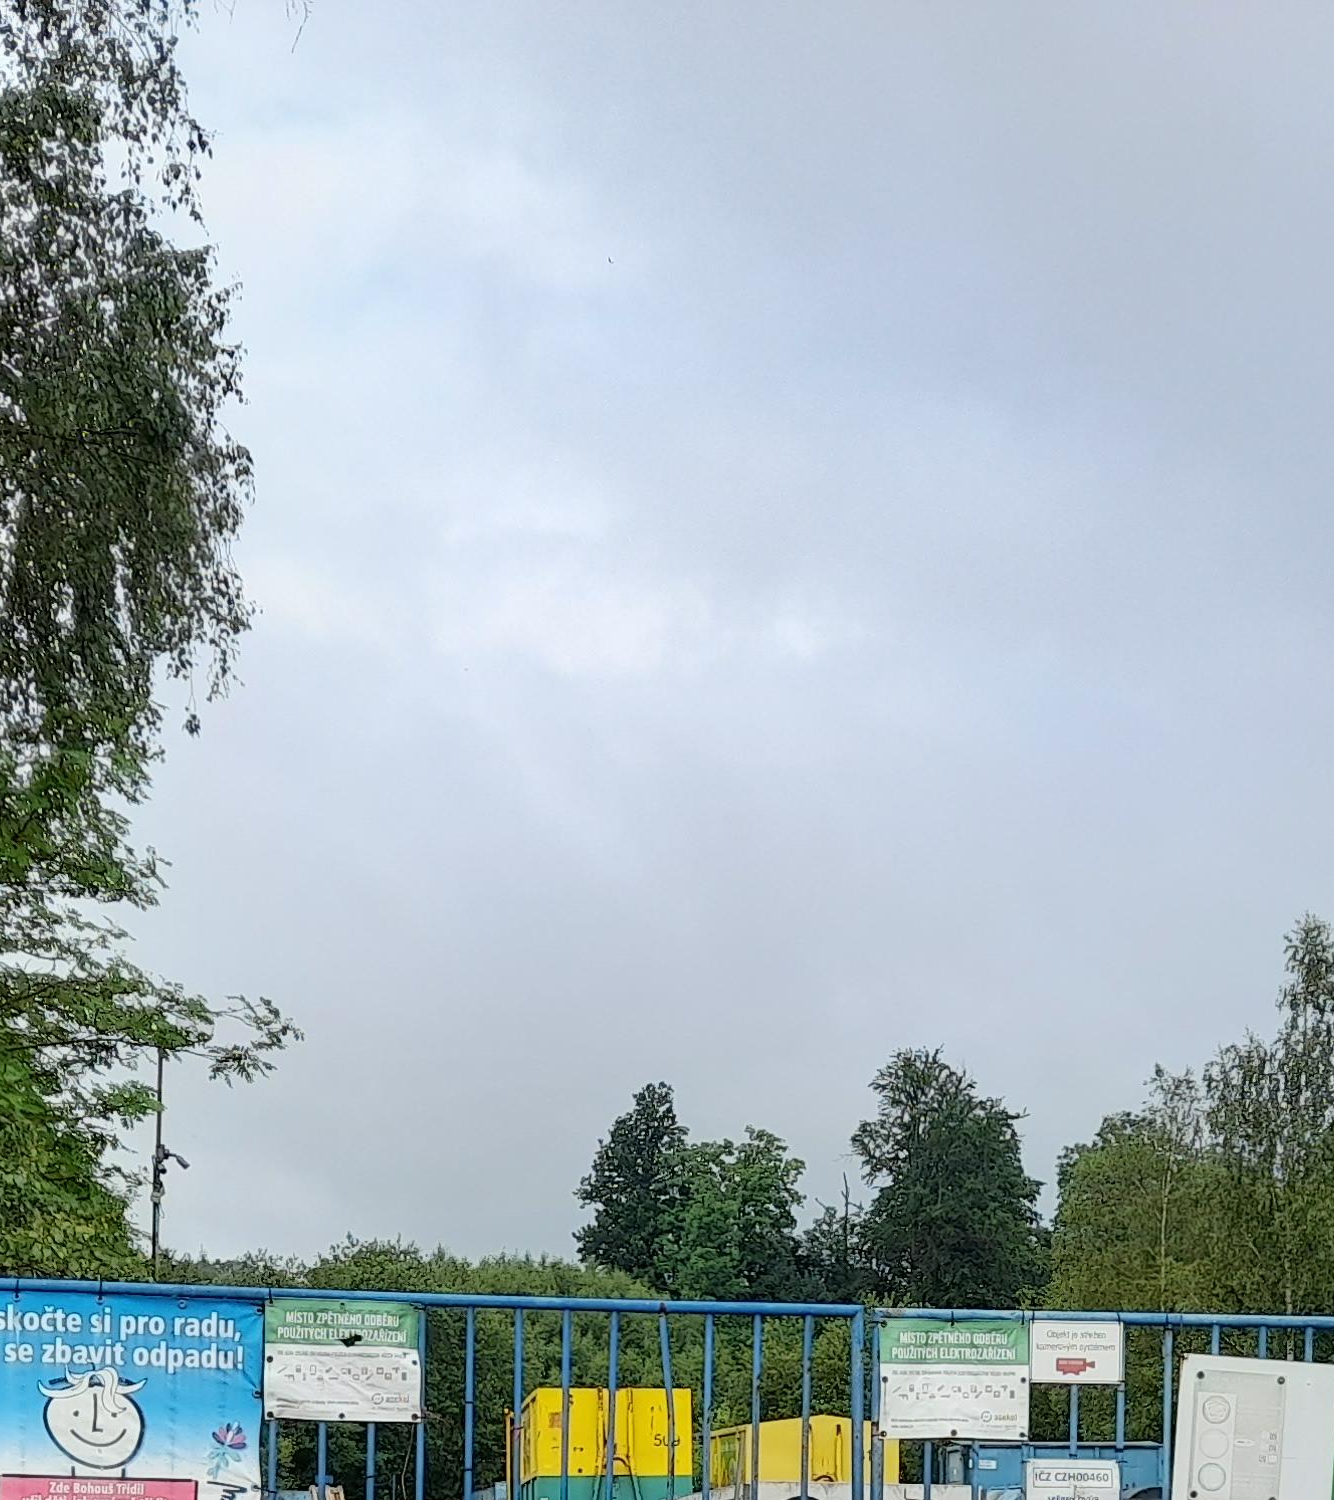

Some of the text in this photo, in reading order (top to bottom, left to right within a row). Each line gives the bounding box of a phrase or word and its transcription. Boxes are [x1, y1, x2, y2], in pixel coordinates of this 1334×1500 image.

[90, 1307, 112, 1334] si
[120, 1313, 165, 1341] pro
[173, 1312, 242, 1342] radu,
[285, 1310, 400, 1327] MÍSTO ZPĚTNÉHO ODBĚRU
[277, 1326, 327, 1340] POUŽITÝCH
[899, 1330, 1008, 1345] MÍSTO ZPĚTNÉHO ODBĚRU
[4, 1341, 33, 1363] se
[41, 1336, 125, 1367] zbavit
[132, 1341, 244, 1374] odpadu!
[891, 1345, 1016, 1360] POUŽITÝCH ELEKTROZAŘÍZENÍ
[1035, 1470, 1052, 1481] IČZ
[49, 1481, 70, 1494] Zde
[73, 1481, 114, 1495] Bohouš
